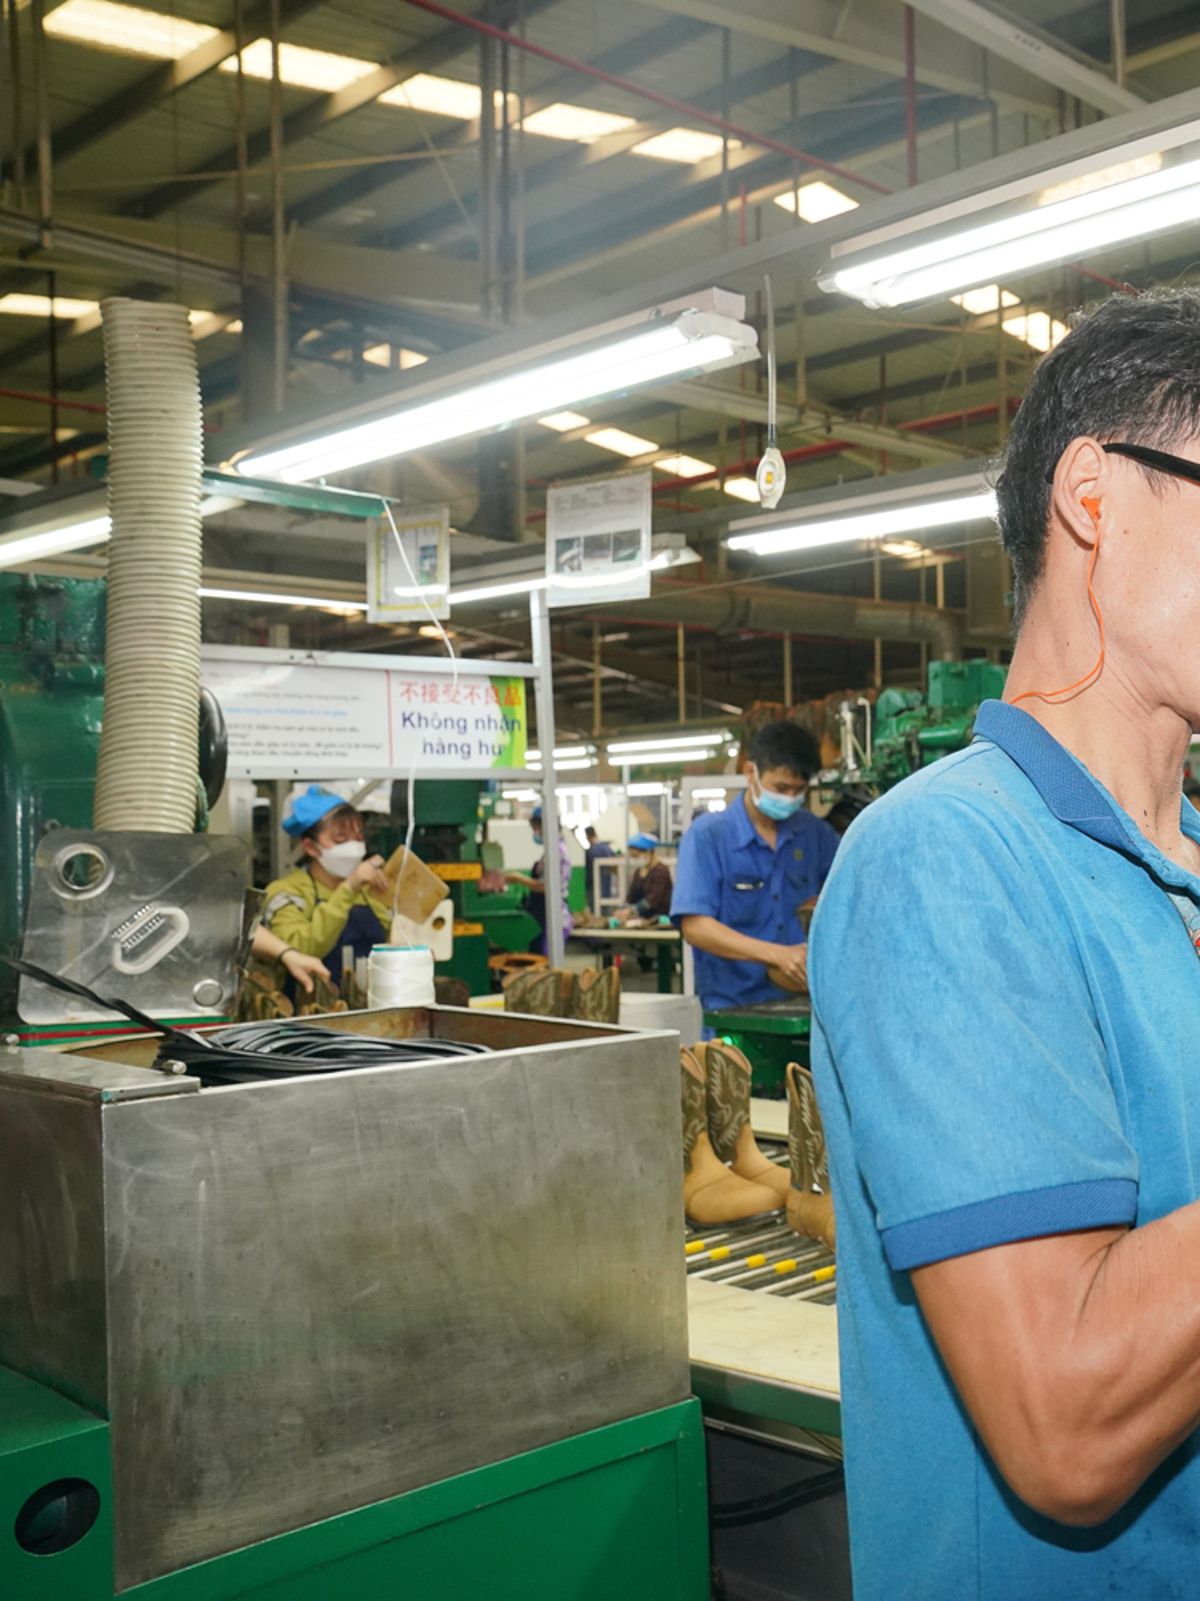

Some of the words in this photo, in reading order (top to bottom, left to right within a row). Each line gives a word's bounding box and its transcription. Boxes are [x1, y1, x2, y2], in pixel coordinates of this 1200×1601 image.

[400, 681, 521, 706] 不接受不良品
[401, 711, 467, 735] Không
[422, 737, 471, 760] hàng
